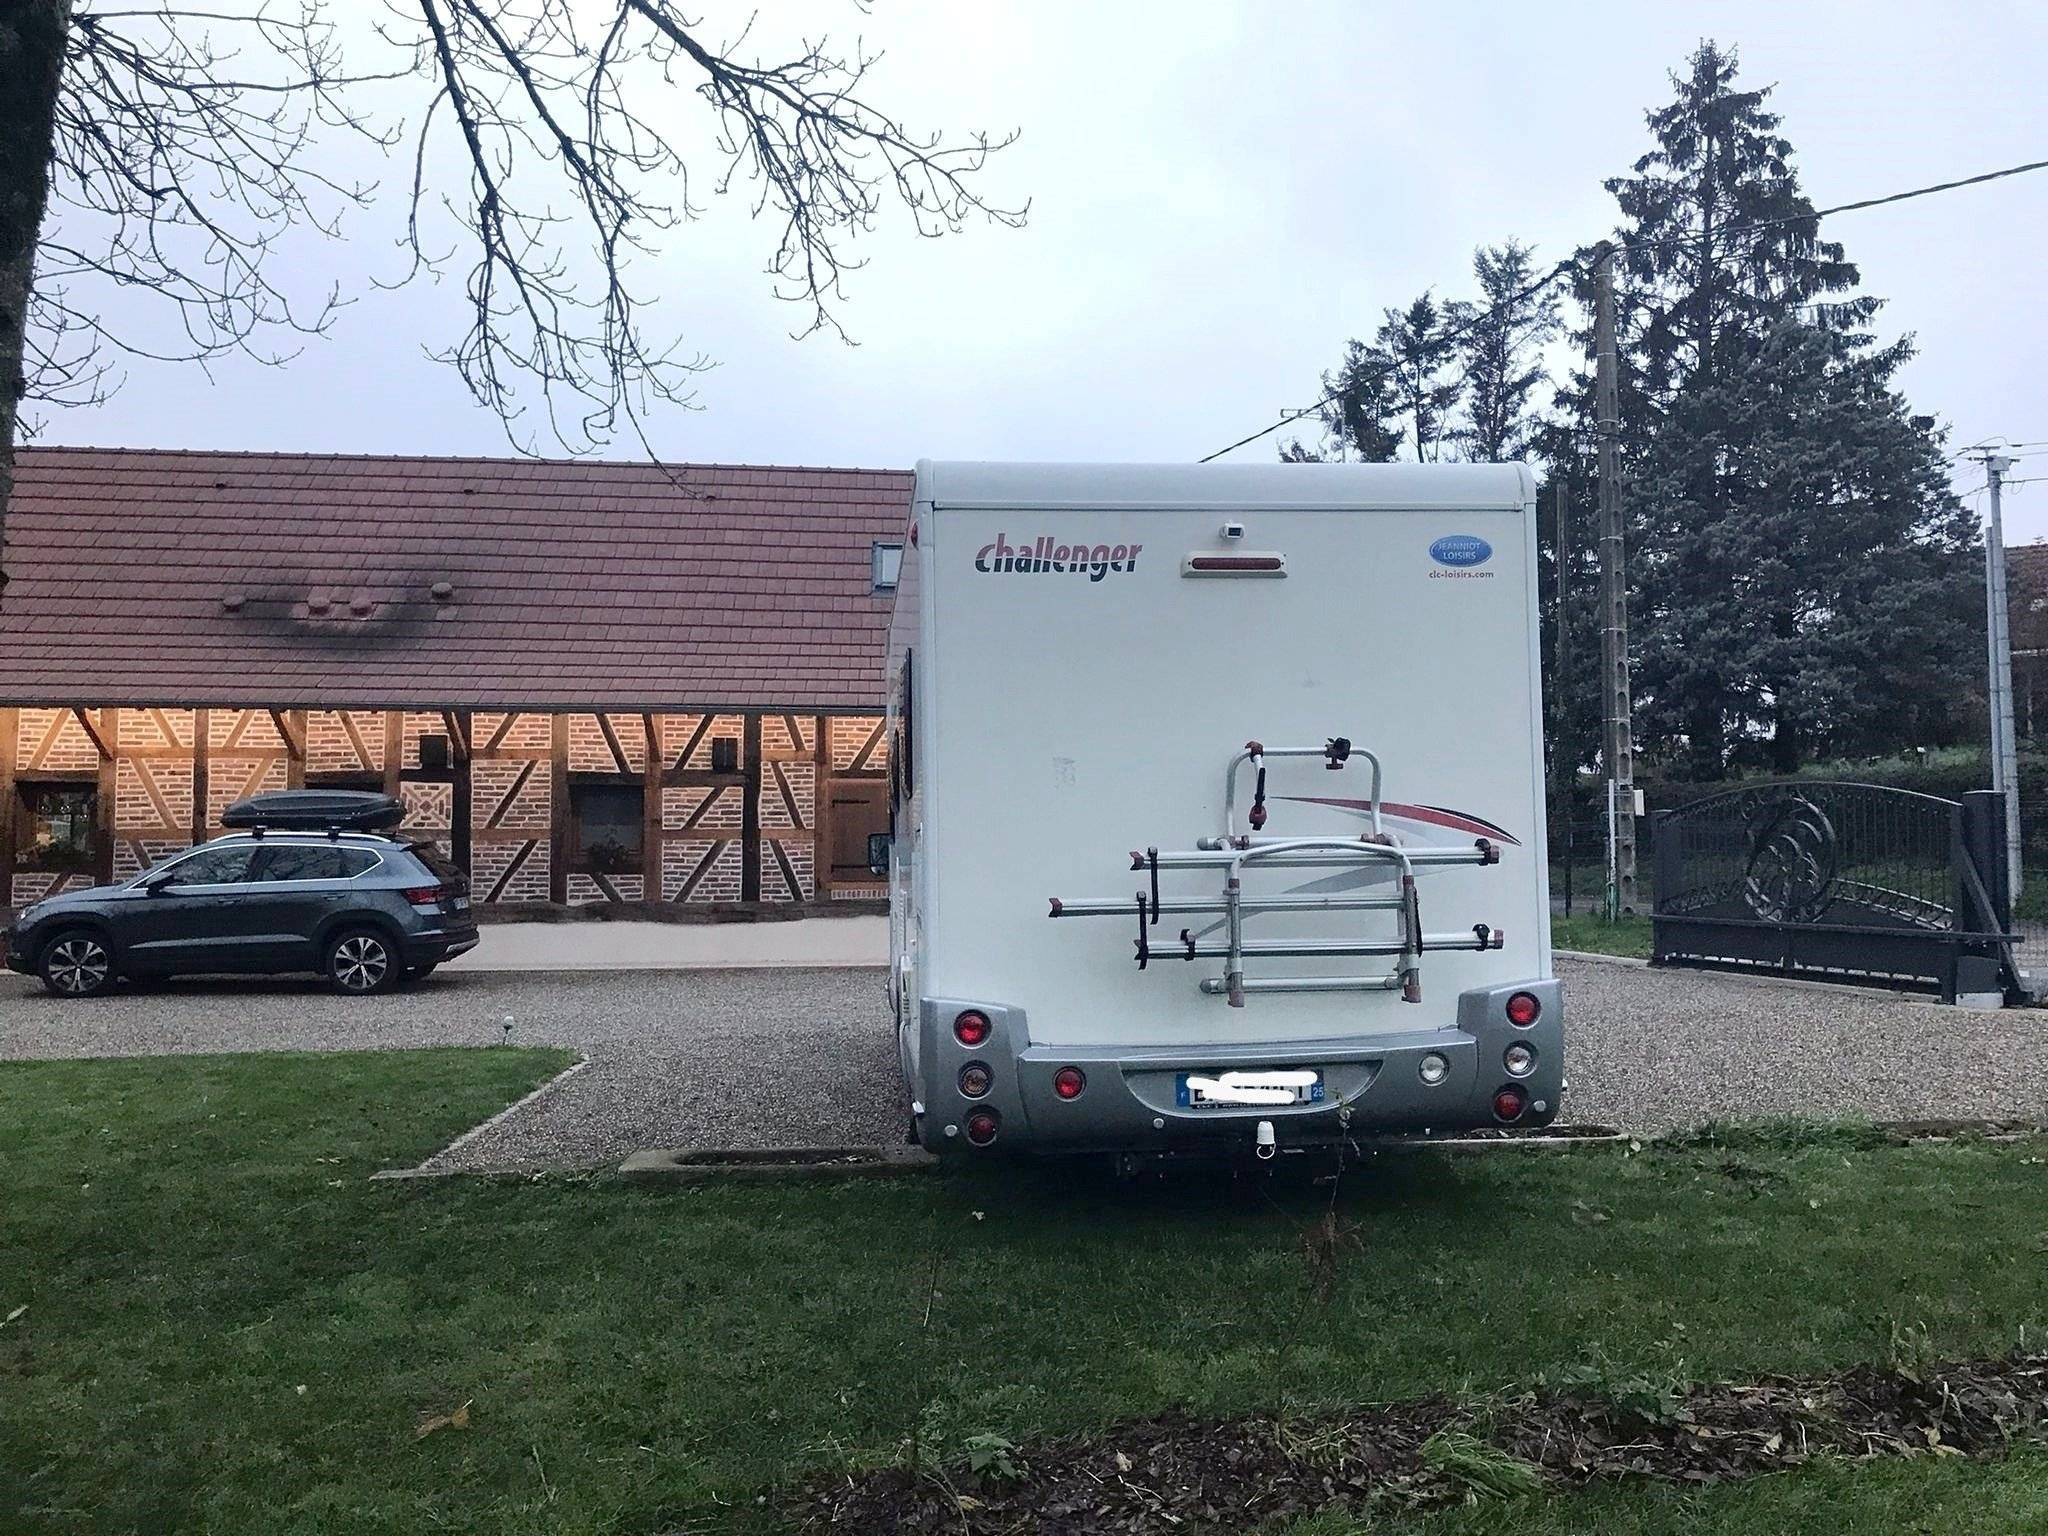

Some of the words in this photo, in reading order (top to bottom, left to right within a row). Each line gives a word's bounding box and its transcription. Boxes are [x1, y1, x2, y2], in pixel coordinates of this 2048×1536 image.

[975, 533, 1143, 582] challenger
[1443, 551, 1476, 560] LOISIRS
[1428, 569, 1494, 579] clc-loisirs.com
[1312, 1087, 1324, 1097] 25
